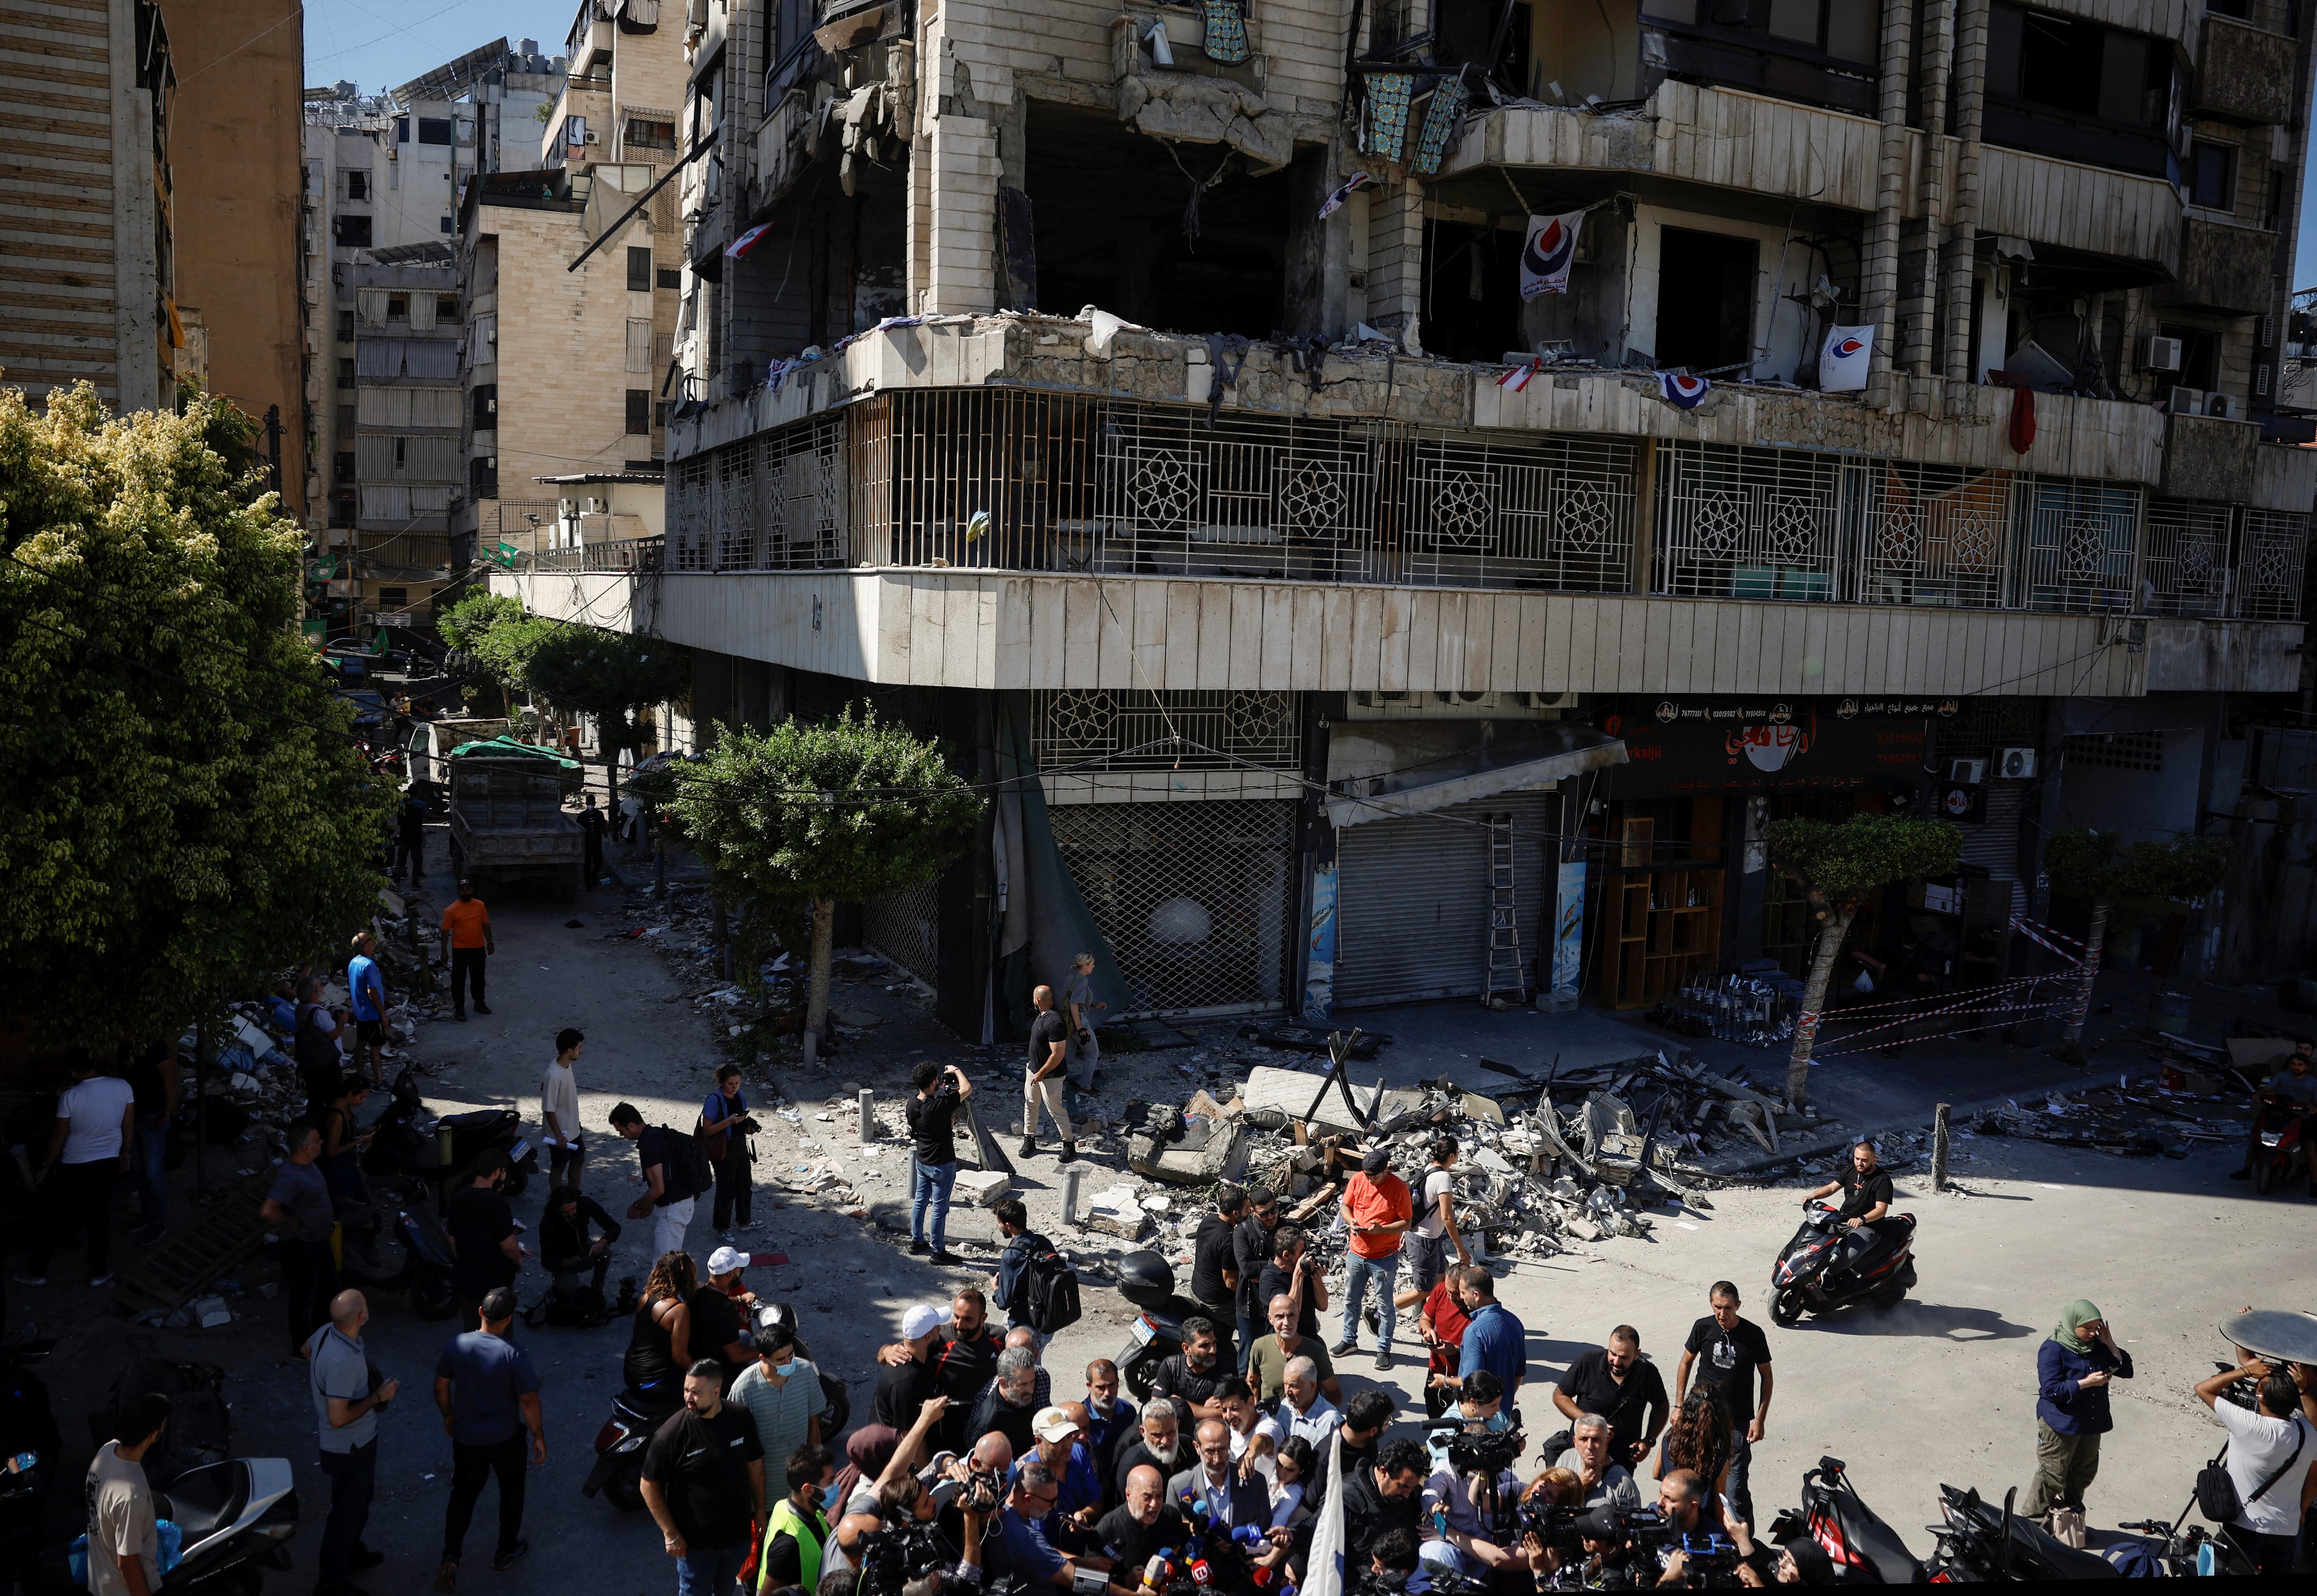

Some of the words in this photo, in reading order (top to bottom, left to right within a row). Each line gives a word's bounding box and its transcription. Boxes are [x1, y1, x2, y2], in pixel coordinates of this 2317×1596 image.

[1905, 705, 1918, 713] جميع
[1877, 733, 1924, 744] 03015982
[1627, 745, 1661, 761] rkaljii
[1876, 753, 1923, 764] 71904513
